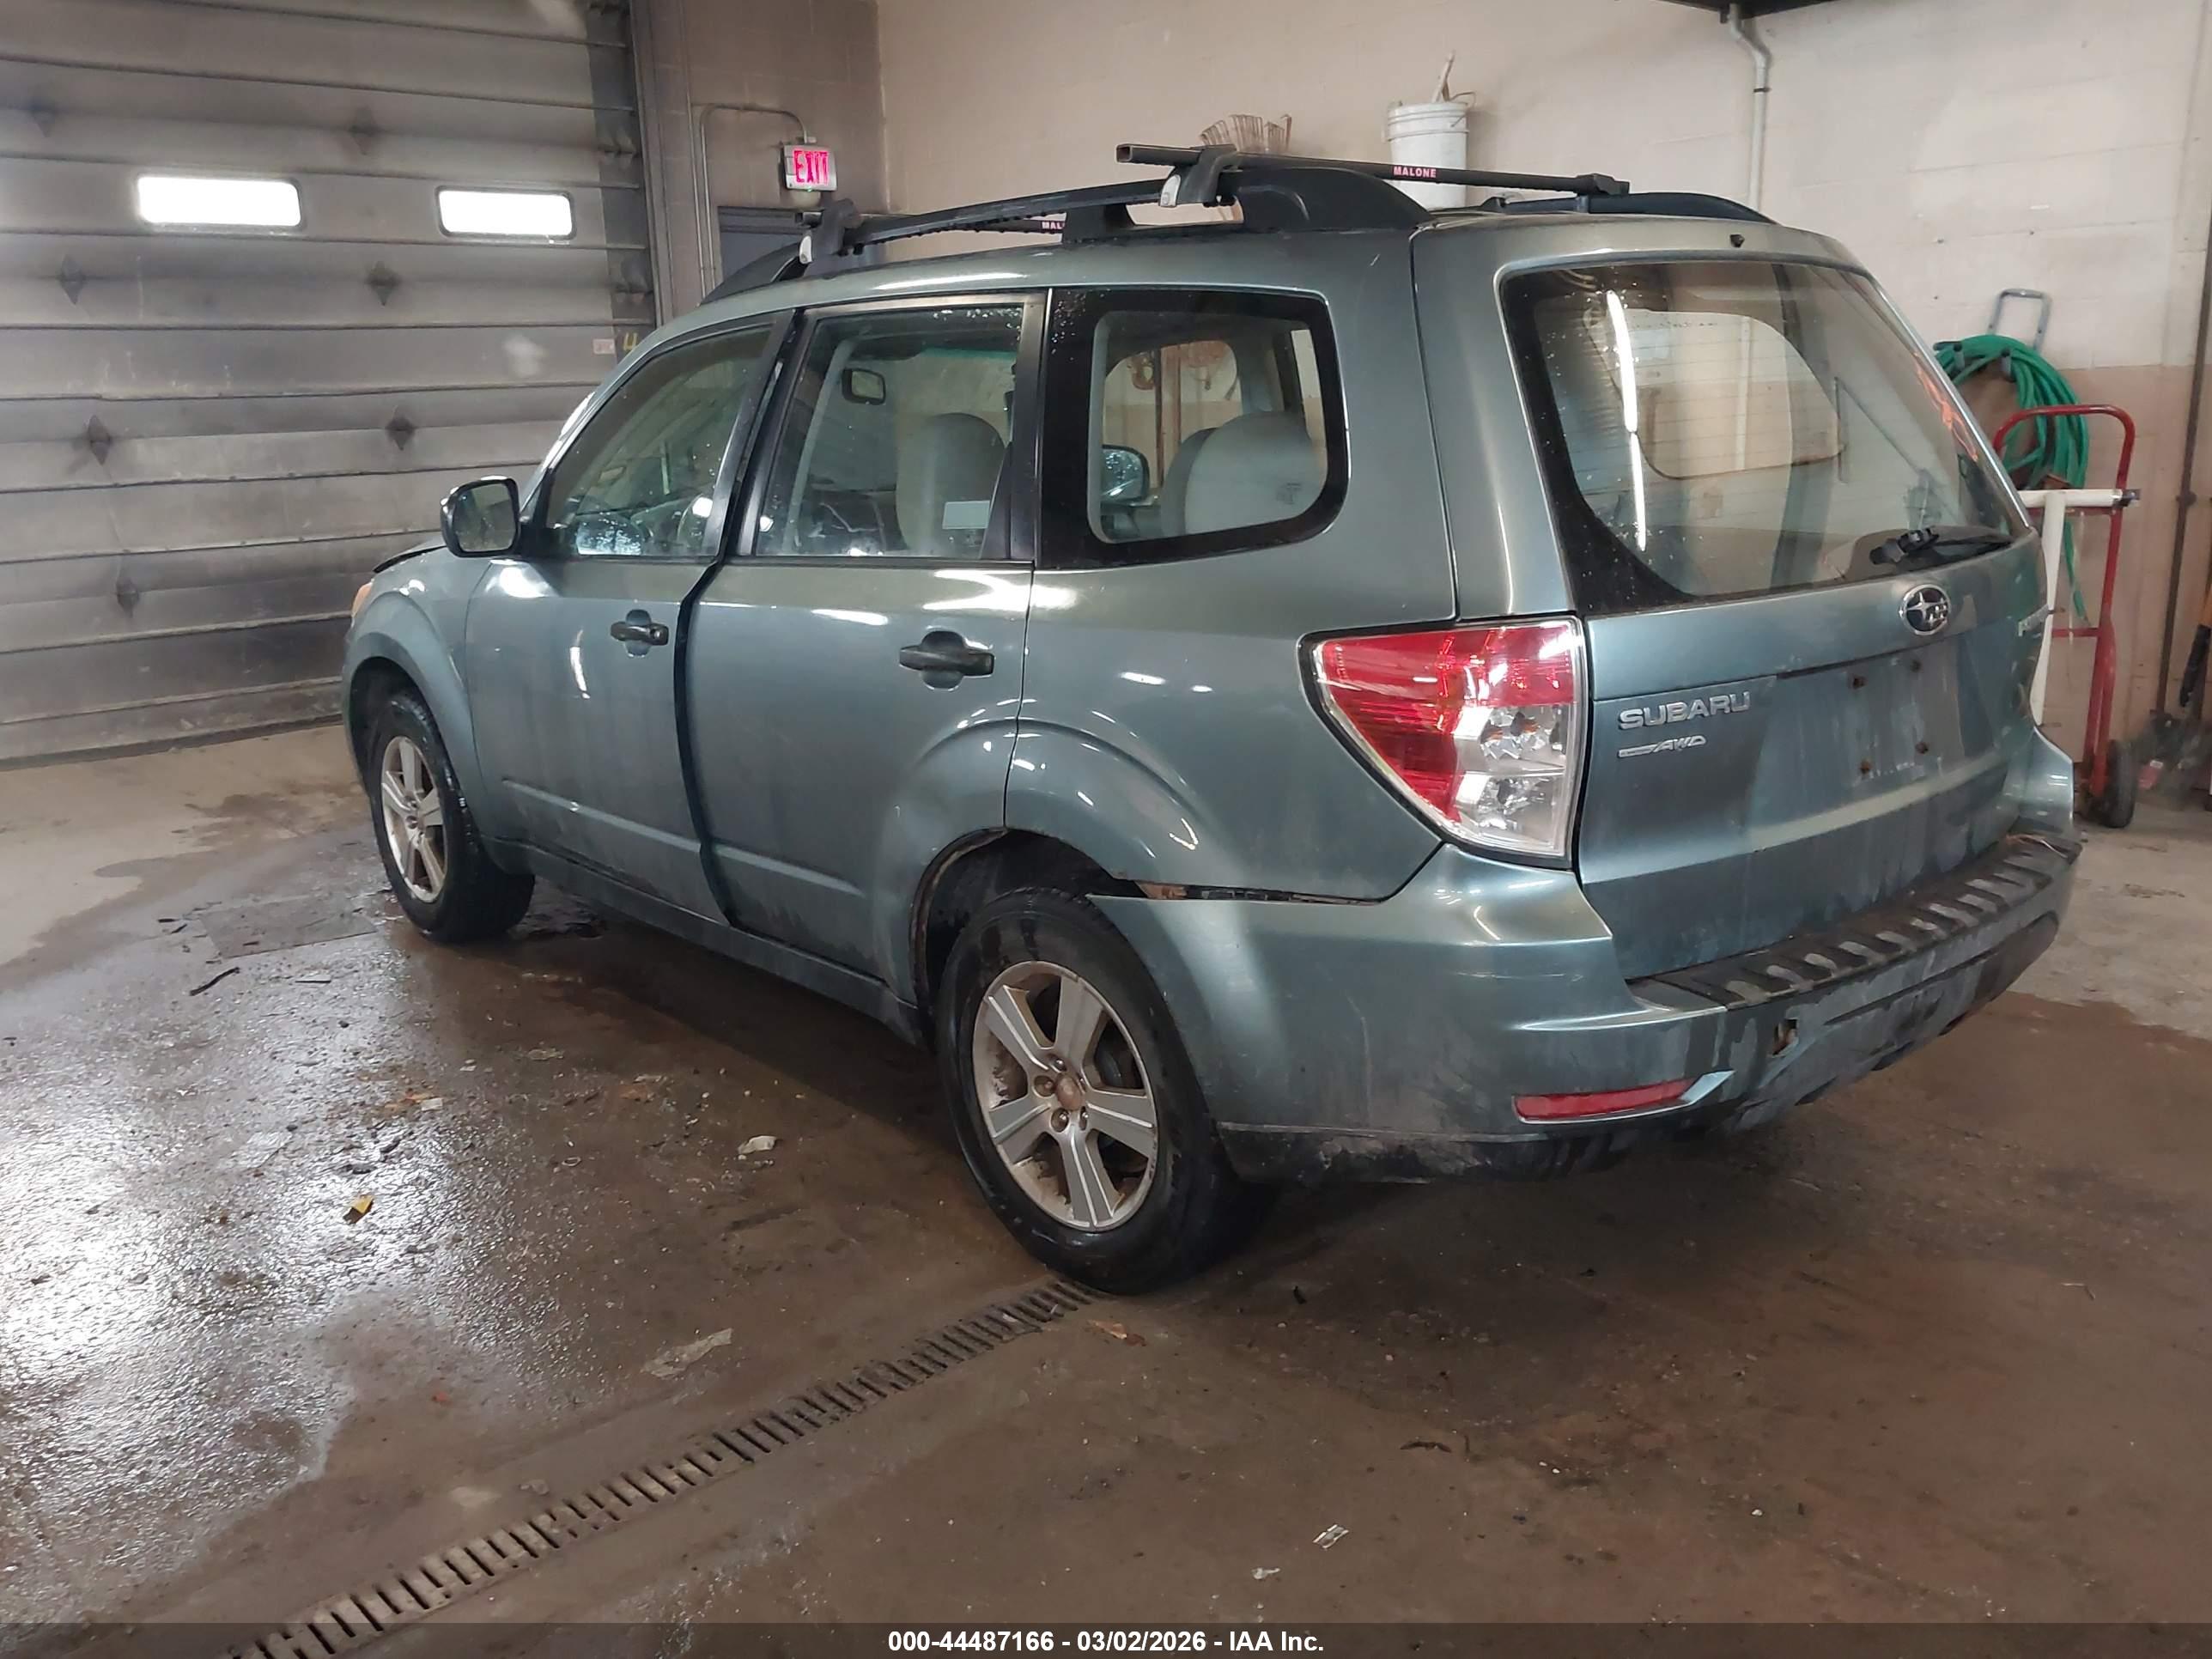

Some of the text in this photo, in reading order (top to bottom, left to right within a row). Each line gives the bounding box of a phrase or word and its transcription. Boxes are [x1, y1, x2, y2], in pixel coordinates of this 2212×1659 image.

[793, 150, 829, 185] EXIT
[1393, 166, 1437, 179] MALONE
[1619, 690, 1751, 730] SUBARU
[1653, 735, 1707, 753] AWD
